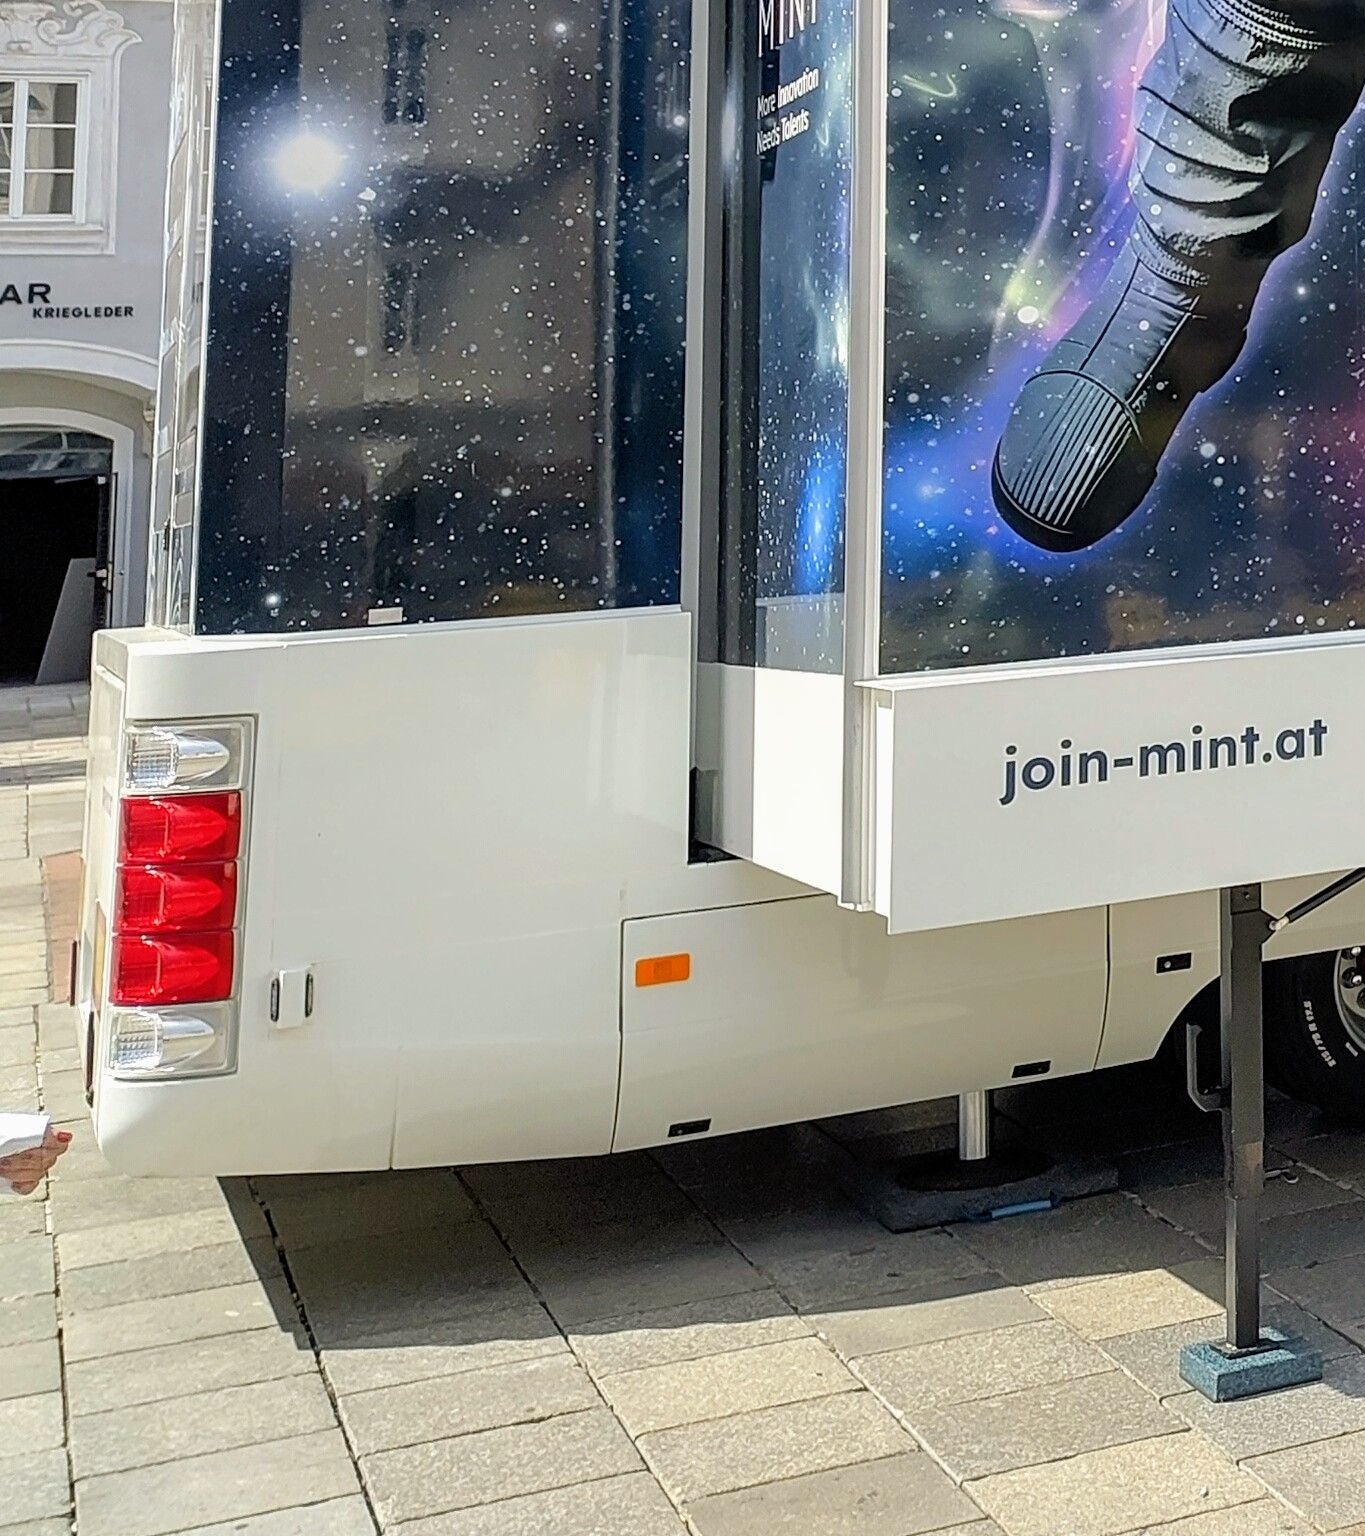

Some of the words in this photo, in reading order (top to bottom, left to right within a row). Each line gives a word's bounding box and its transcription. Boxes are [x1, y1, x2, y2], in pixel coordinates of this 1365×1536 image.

[756, 94, 776, 120] More
[777, 66, 819, 110] Innovation
[756, 122, 780, 155] Needs
[780, 109, 810, 142] Talents
[32, 306, 134, 319] KRIEGLEDER
[999, 719, 1328, 806] join-mint.at
